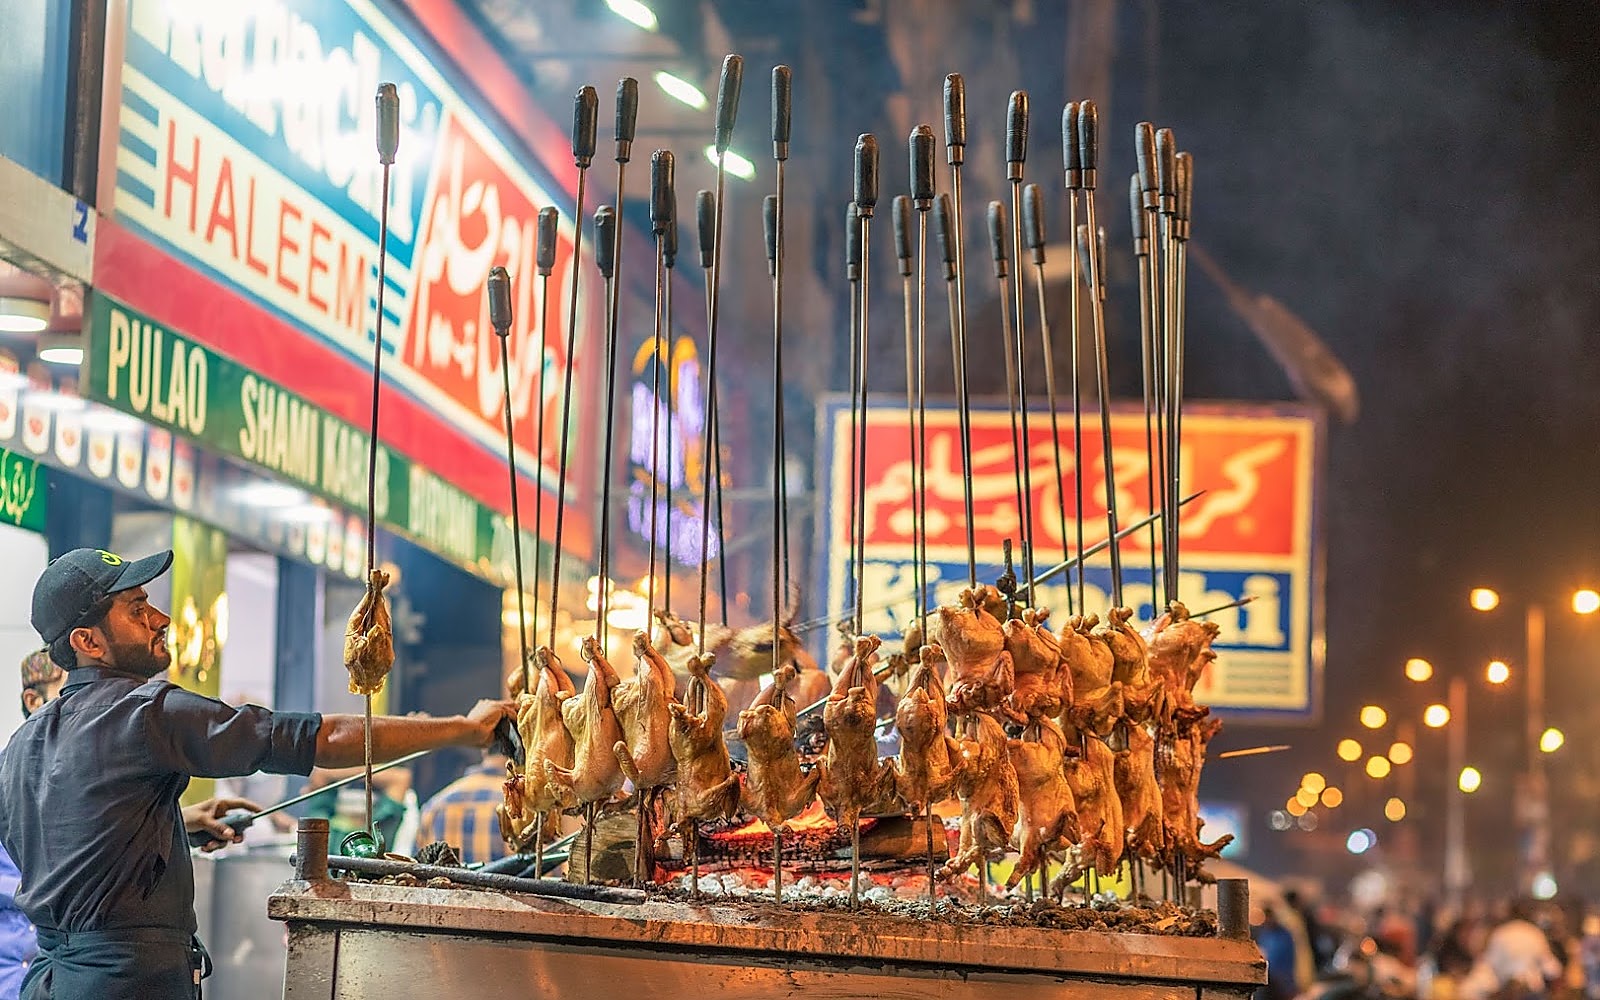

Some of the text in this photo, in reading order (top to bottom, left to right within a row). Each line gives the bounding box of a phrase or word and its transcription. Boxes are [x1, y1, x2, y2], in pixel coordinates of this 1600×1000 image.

[164, 118, 367, 341] HALEEM
[108, 309, 208, 435] PULAO
[239, 374, 319, 486] SHAMI
[853, 563, 1286, 645] Kchi
